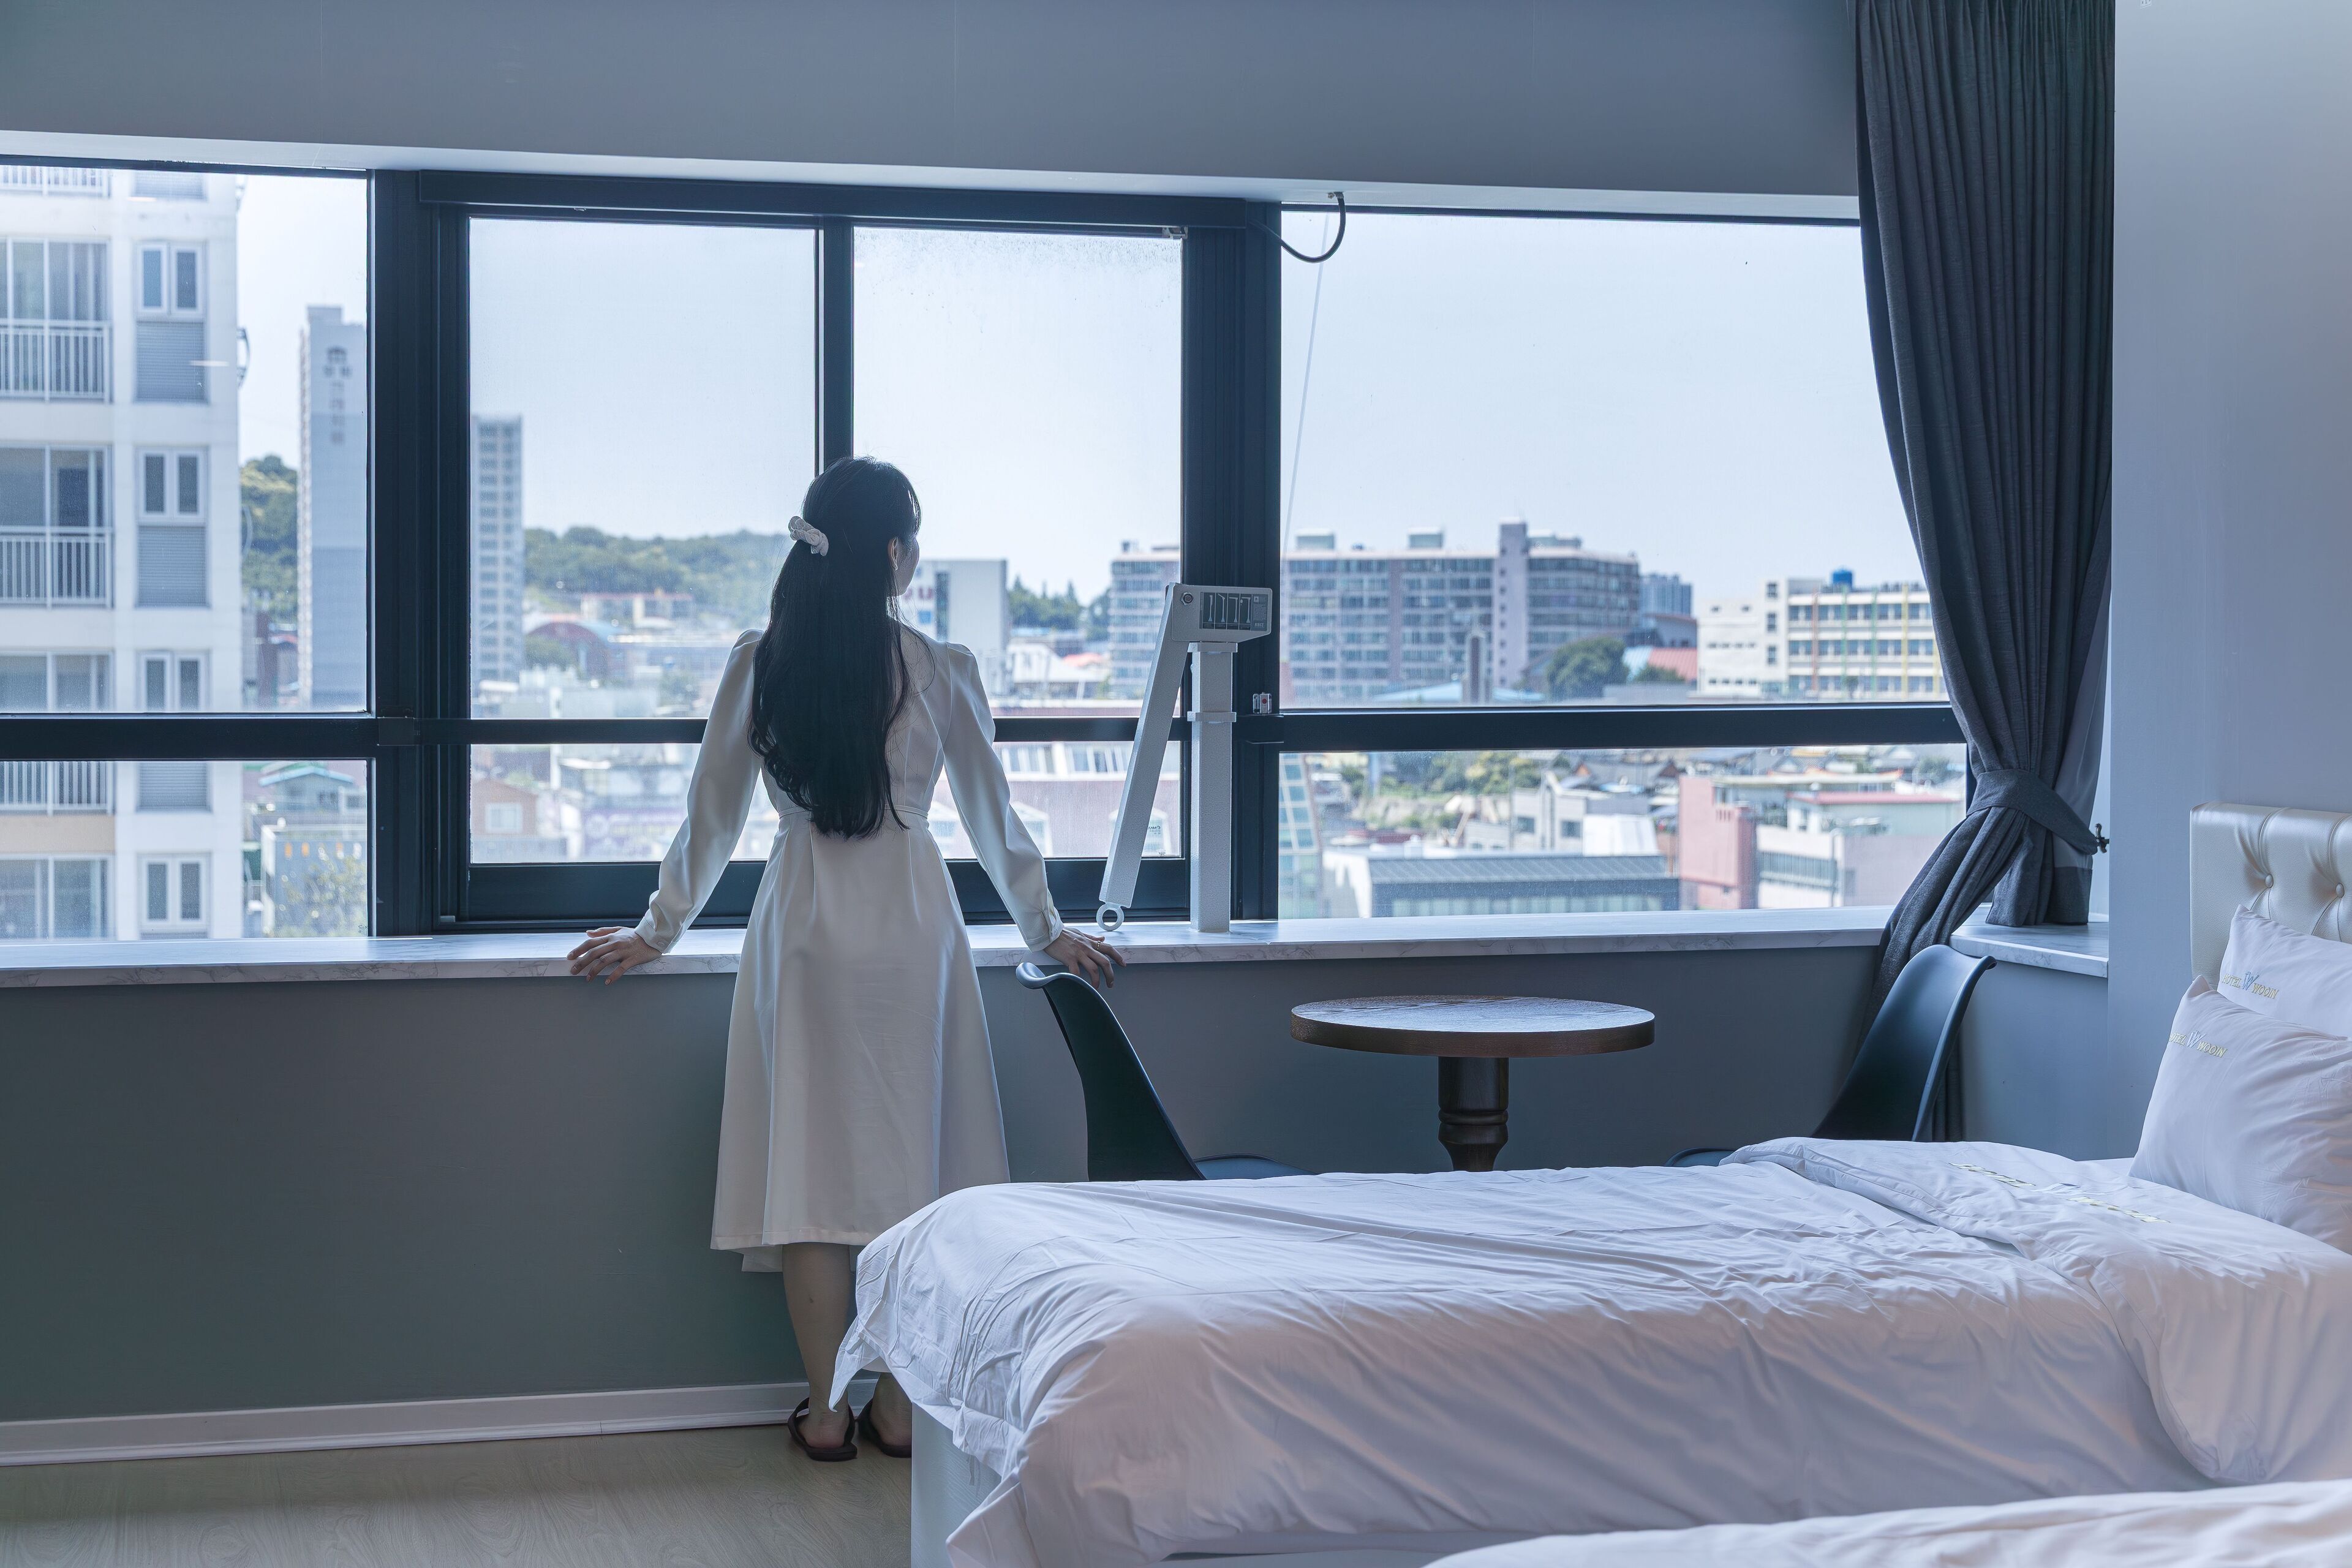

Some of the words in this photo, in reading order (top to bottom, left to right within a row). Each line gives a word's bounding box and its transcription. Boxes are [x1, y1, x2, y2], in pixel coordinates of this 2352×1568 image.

[2222, 974, 2242, 989] HOTEL
[2252, 983, 2279, 999] WOOIN
[2197, 1042, 2228, 1058] WOOIN
